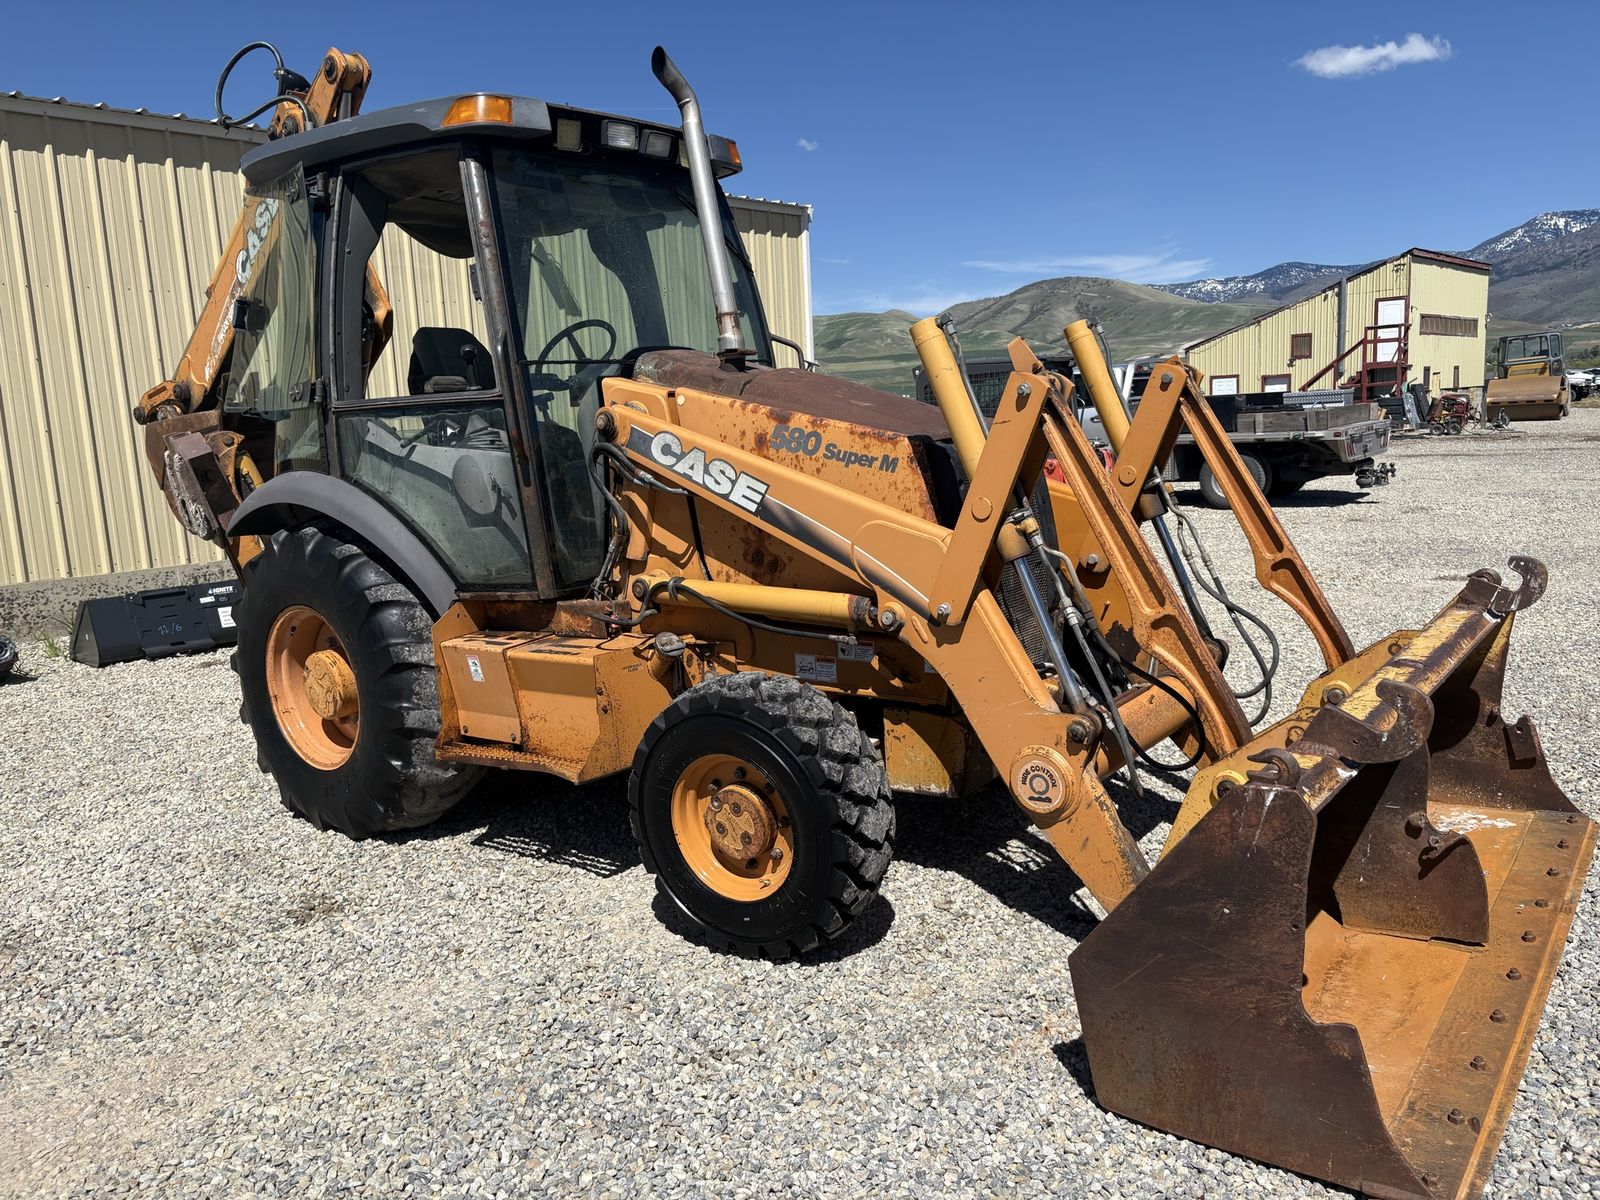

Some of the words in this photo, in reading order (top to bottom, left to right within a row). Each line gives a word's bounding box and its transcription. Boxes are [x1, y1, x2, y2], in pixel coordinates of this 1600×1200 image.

[650, 431, 769, 513] CASE
[769, 424, 822, 456] 580
[823, 442, 878, 469] Super
[878, 454, 899, 473] M
[1021, 768, 1031, 785] RIDE
[1030, 765, 1057, 788] CONTROL
